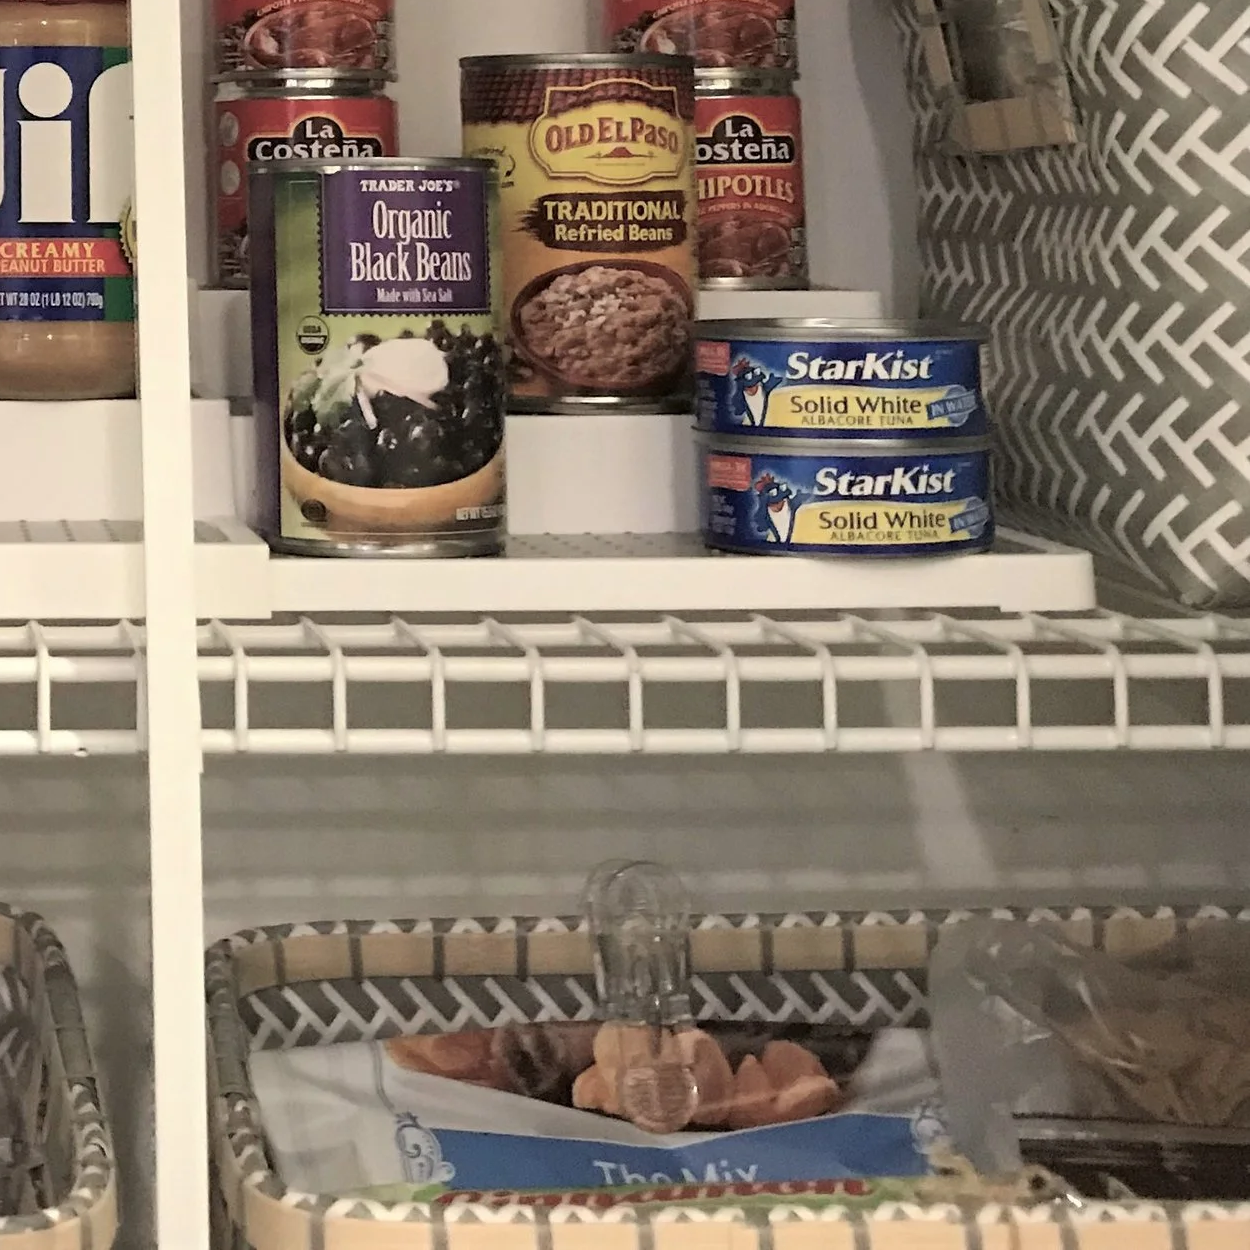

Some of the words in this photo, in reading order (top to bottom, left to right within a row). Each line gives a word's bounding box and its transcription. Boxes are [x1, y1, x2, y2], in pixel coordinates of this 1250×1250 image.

[305, 119, 335, 139] La
[545, 123, 594, 154] OLD
[597, 117, 629, 144] EL
[724, 119, 755, 139] La
[254, 139, 374, 161] Costeña
[694, 138, 790, 161] osteña
[359, 179, 415, 192] TRADER
[418, 179, 453, 192] JOE'S
[698, 174, 794, 204] IPOTLES
[543, 200, 682, 221] TRADITIONAL
[372, 200, 452, 245] Organic
[554, 223, 625, 242] Refried
[628, 224, 673, 241] Beans
[53, 259, 106, 273] BUTTER
[349, 242, 411, 282] Black
[415, 242, 472, 282] Beans
[6, 292, 18, 306] WT
[30, 292, 40, 306] OZ
[51, 292, 61, 306] LB
[62, 292, 71, 306] 12
[376, 287, 400, 302] Made
[402, 287, 421, 302] with
[422, 288, 437, 302] Sea
[786, 349, 934, 381] StarKist
[790, 395, 848, 415] Solid
[855, 395, 922, 415] White
[801, 415, 873, 426] ALBACORE
[879, 415, 914, 426] TUNA
[813, 465, 956, 496] StarKist
[819, 511, 877, 531] Solid
[884, 509, 946, 529] White
[830, 531, 902, 542] ALBACORE
[907, 529, 940, 541] TUNA
